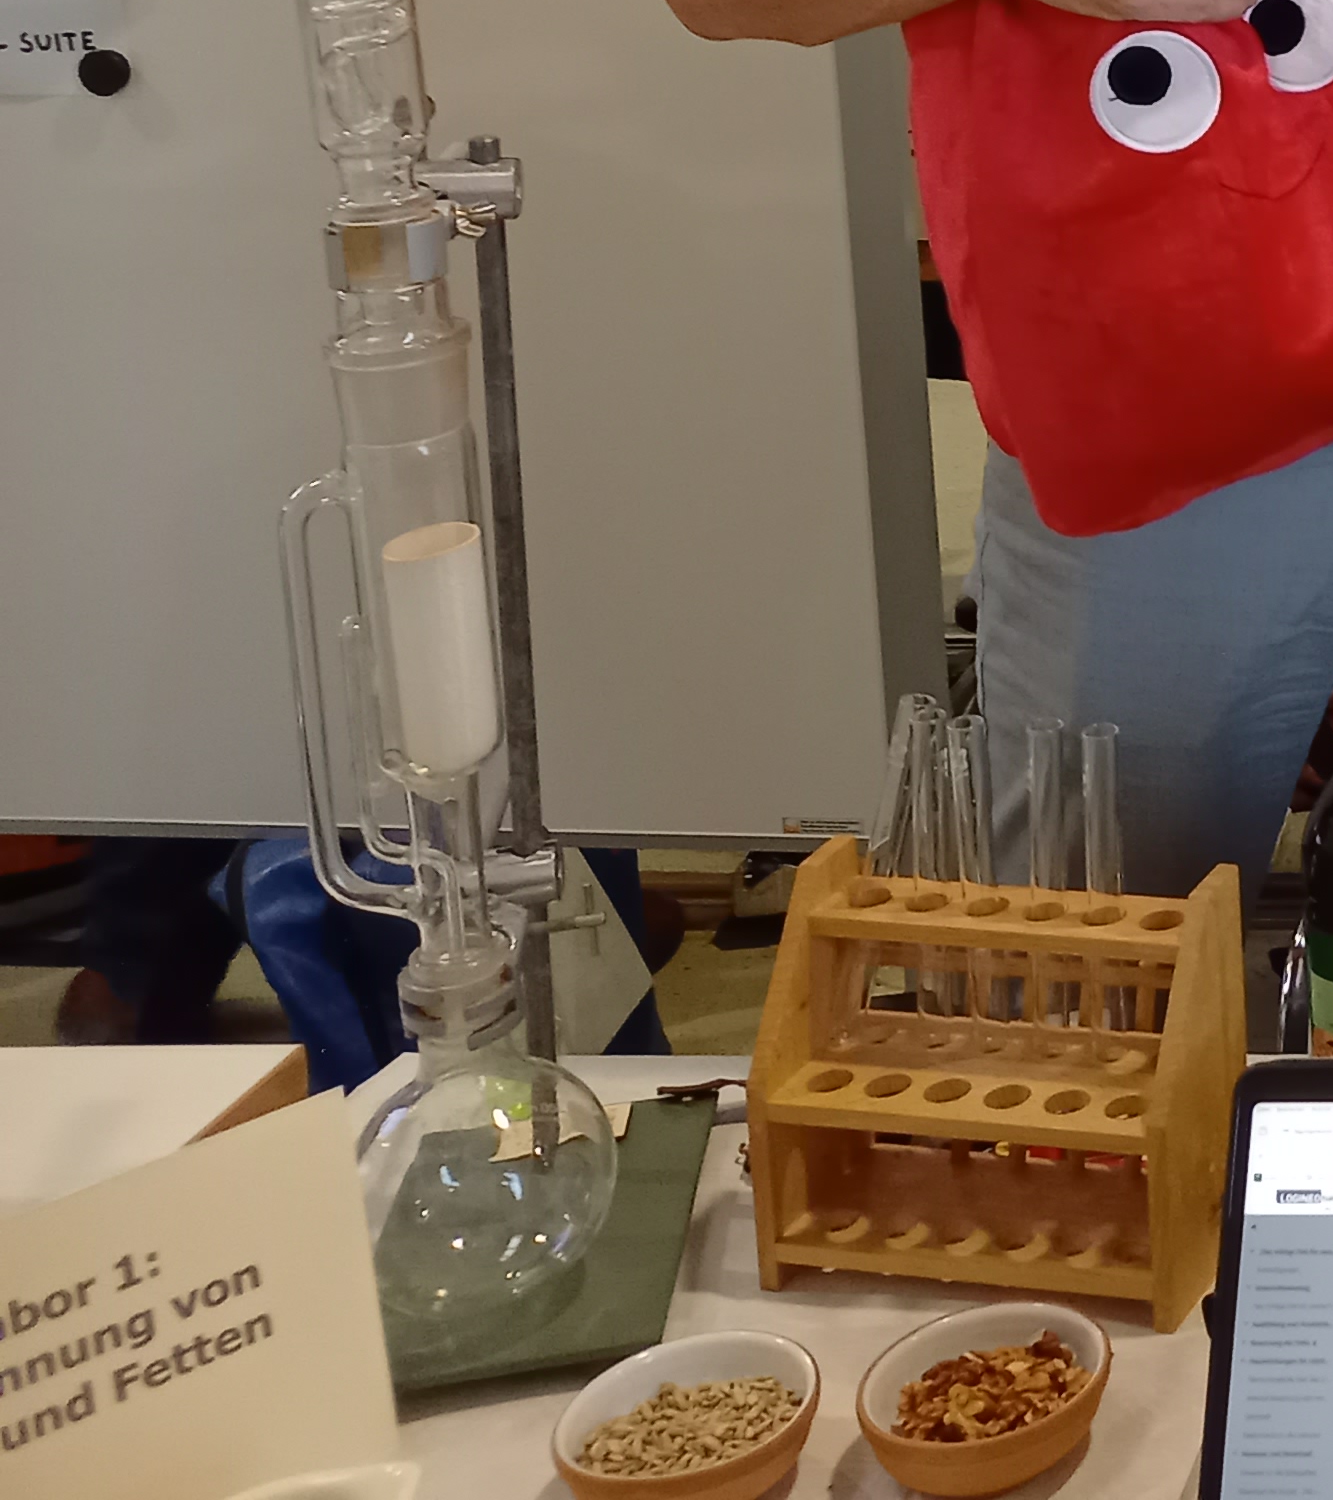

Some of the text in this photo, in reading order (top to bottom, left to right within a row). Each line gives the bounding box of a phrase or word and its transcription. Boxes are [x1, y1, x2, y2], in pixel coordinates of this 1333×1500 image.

[20, 31, 97, 53] SUITE
[0, 1251, 161, 1343] bor 1:
[170, 1263, 262, 1320] von
[1, 1312, 274, 1452] und Fetten
